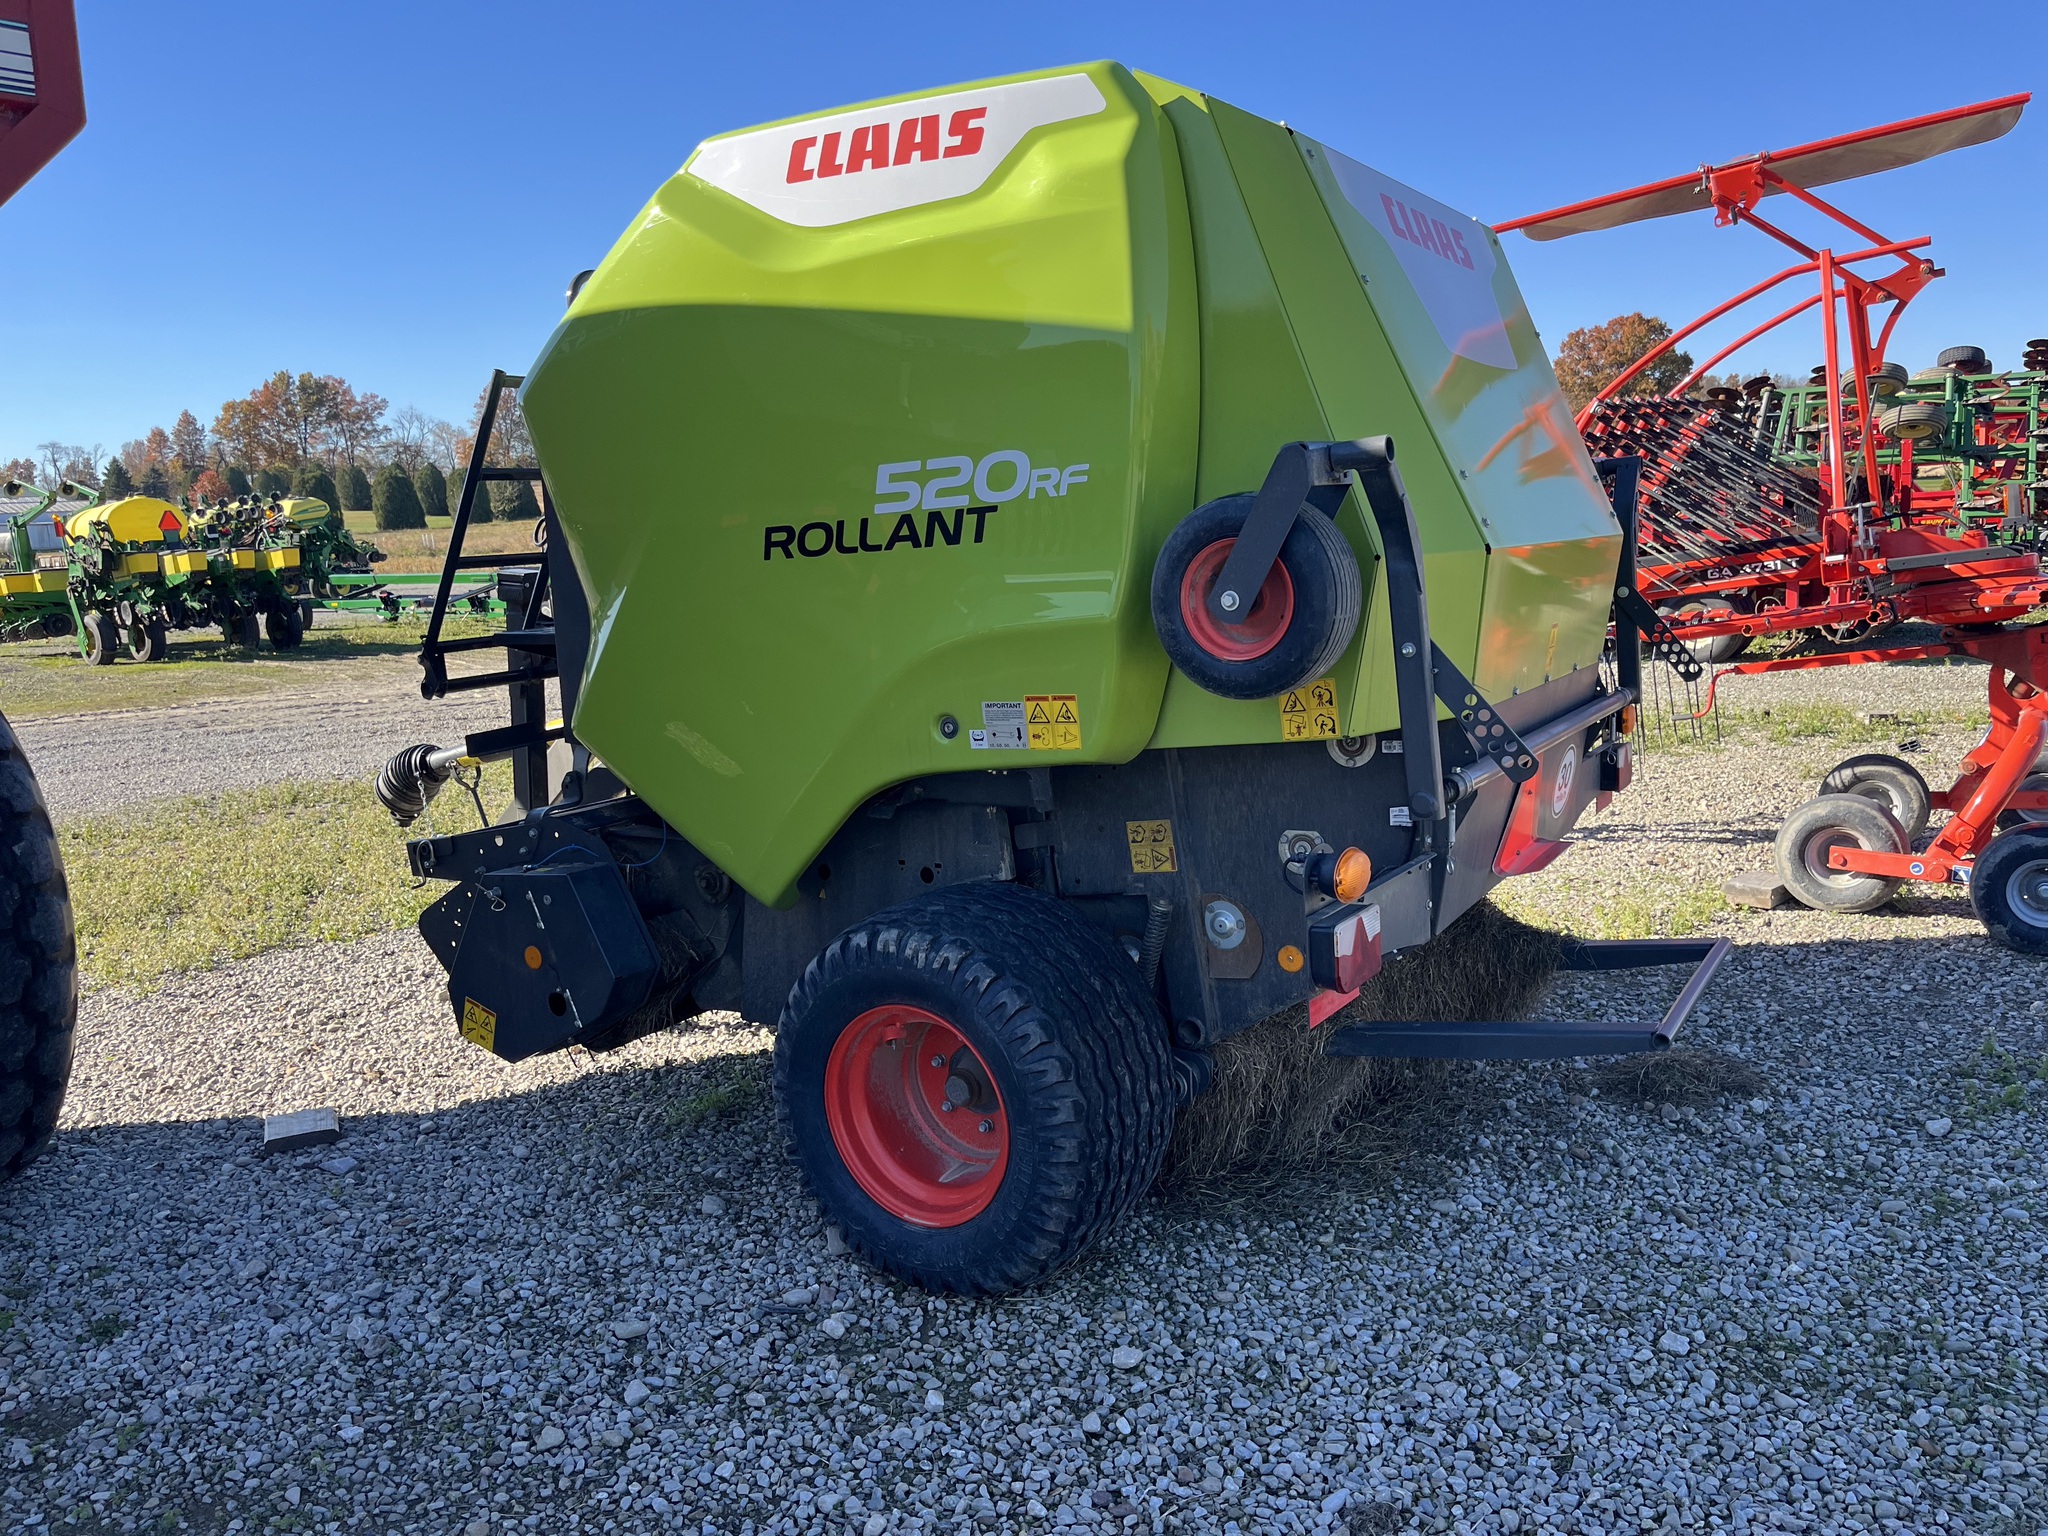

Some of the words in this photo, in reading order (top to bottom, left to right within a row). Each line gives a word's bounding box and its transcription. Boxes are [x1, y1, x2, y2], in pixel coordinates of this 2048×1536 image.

[786, 107, 987, 184] CLAAS
[1379, 192, 1475, 272] CLAAS
[763, 505, 998, 561] ROLLANT
[1707, 567, 1733, 580] GA
[1558, 760, 1572, 791] 30
